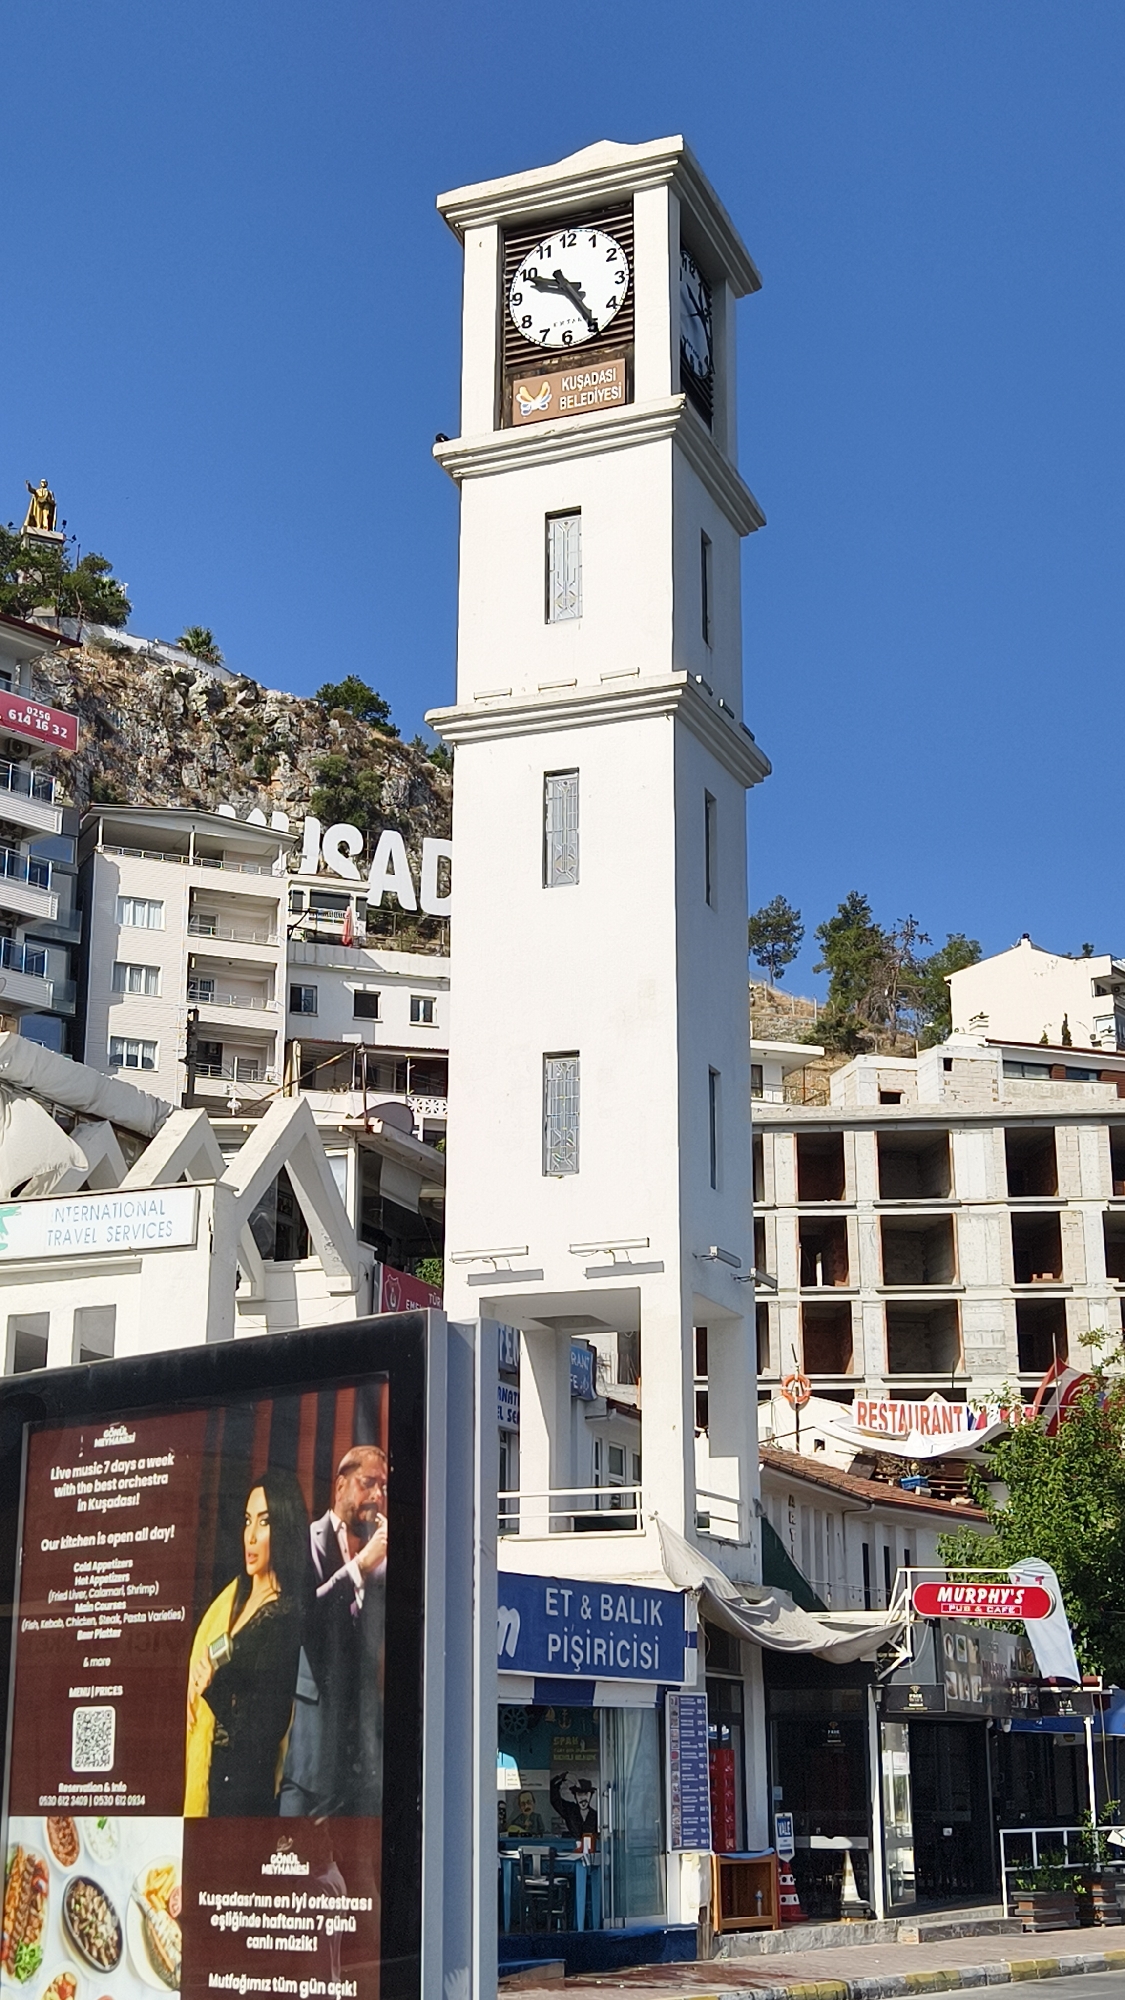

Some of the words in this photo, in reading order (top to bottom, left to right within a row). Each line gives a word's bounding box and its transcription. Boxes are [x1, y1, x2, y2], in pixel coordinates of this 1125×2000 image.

[560, 233, 576, 248] 12
[588, 234, 596, 248] 1
[536, 245, 552, 260] 11
[606, 248, 617, 262] 2
[520, 268, 538, 282] 10
[614, 270, 626, 284] 3
[512, 292, 523, 306] 9
[606, 296, 618, 309] 4
[522, 315, 532, 328] 8
[539, 328, 550, 342] 7
[562, 330, 573, 344] 6
[562, 367, 616, 392] KUŞADASI
[560, 382, 622, 410] BELEDİYESİ
[8, 709, 31, 726] 614
[36, 719, 49, 731] 16
[52, 724, 68, 738] 32
[51, 1200, 166, 1223] INTERNATIONAL
[47, 1227, 97, 1247] TRAVEL
[106, 1220, 173, 1243] SERVICES
[857, 1401, 963, 1436] RESTAURANT
[50, 1466, 72, 1480] Live
[72, 1462, 103, 1478] music
[104, 1460, 110, 1474] 7
[111, 1460, 136, 1475] days
[138, 1459, 146, 1470] a
[147, 1452, 175, 1467] week
[54, 1482, 76, 1498] with
[77, 1480, 94, 1494] the
[94, 1478, 117, 1492] best
[118, 1473, 168, 1490] orchestra
[77, 1498, 86, 1512] in
[88, 1492, 140, 1514] Kuşadası!
[41, 1539, 60, 1552] Our
[60, 1534, 96, 1550] kitchen
[97, 1531, 106, 1546] is
[107, 1532, 134, 1548] open
[135, 1527, 148, 1542] all
[150, 1524, 176, 1542] day!
[73, 1562, 92, 1573] Cold
[92, 1558, 134, 1573] Appetizers
[74, 1576, 89, 1586] Hot
[90, 1572, 130, 1587] Appetizers
[126, 1581, 160, 1596] Shrimp)
[937, 1586, 1025, 1604] MURPHY'S
[74, 1602, 94, 1614] Main
[94, 1600, 126, 1612] Courses
[148, 1606, 186, 1622] Varieties)
[546, 1587, 573, 1617] ET
[580, 1594, 592, 1620] &
[600, 1596, 664, 1627] BALIK
[948, 1604, 971, 1612] PUB
[986, 1606, 1016, 1614] CAFE
[547, 1626, 661, 1672] PİŞİRİCİSİ
[90, 1657, 112, 1667] more
[68, 1686, 90, 1698] MENU
[94, 1685, 124, 1696] PRICES
[58, 1781, 103, 1792] Reservation
[111, 1780, 127, 1792] Info
[199, 1892, 272, 1910] Kuşadası'nın
[274, 1895, 290, 1909] en
[292, 1892, 308, 1913] iyi
[308, 1893, 372, 1911] orkestrası
[210, 1911, 261, 1932] eşliğinde
[262, 1913, 314, 1930] haftanın
[316, 1915, 324, 1930] 7
[326, 1916, 356, 1936] günü
[246, 1934, 272, 1950] canlı
[274, 1936, 318, 1952] müzik!
[208, 1972, 272, 1994] Mutfağımız
[272, 1976, 298, 1993] tüm
[300, 1978, 326, 1998] gün
[327, 1980, 358, 2000] açık!
